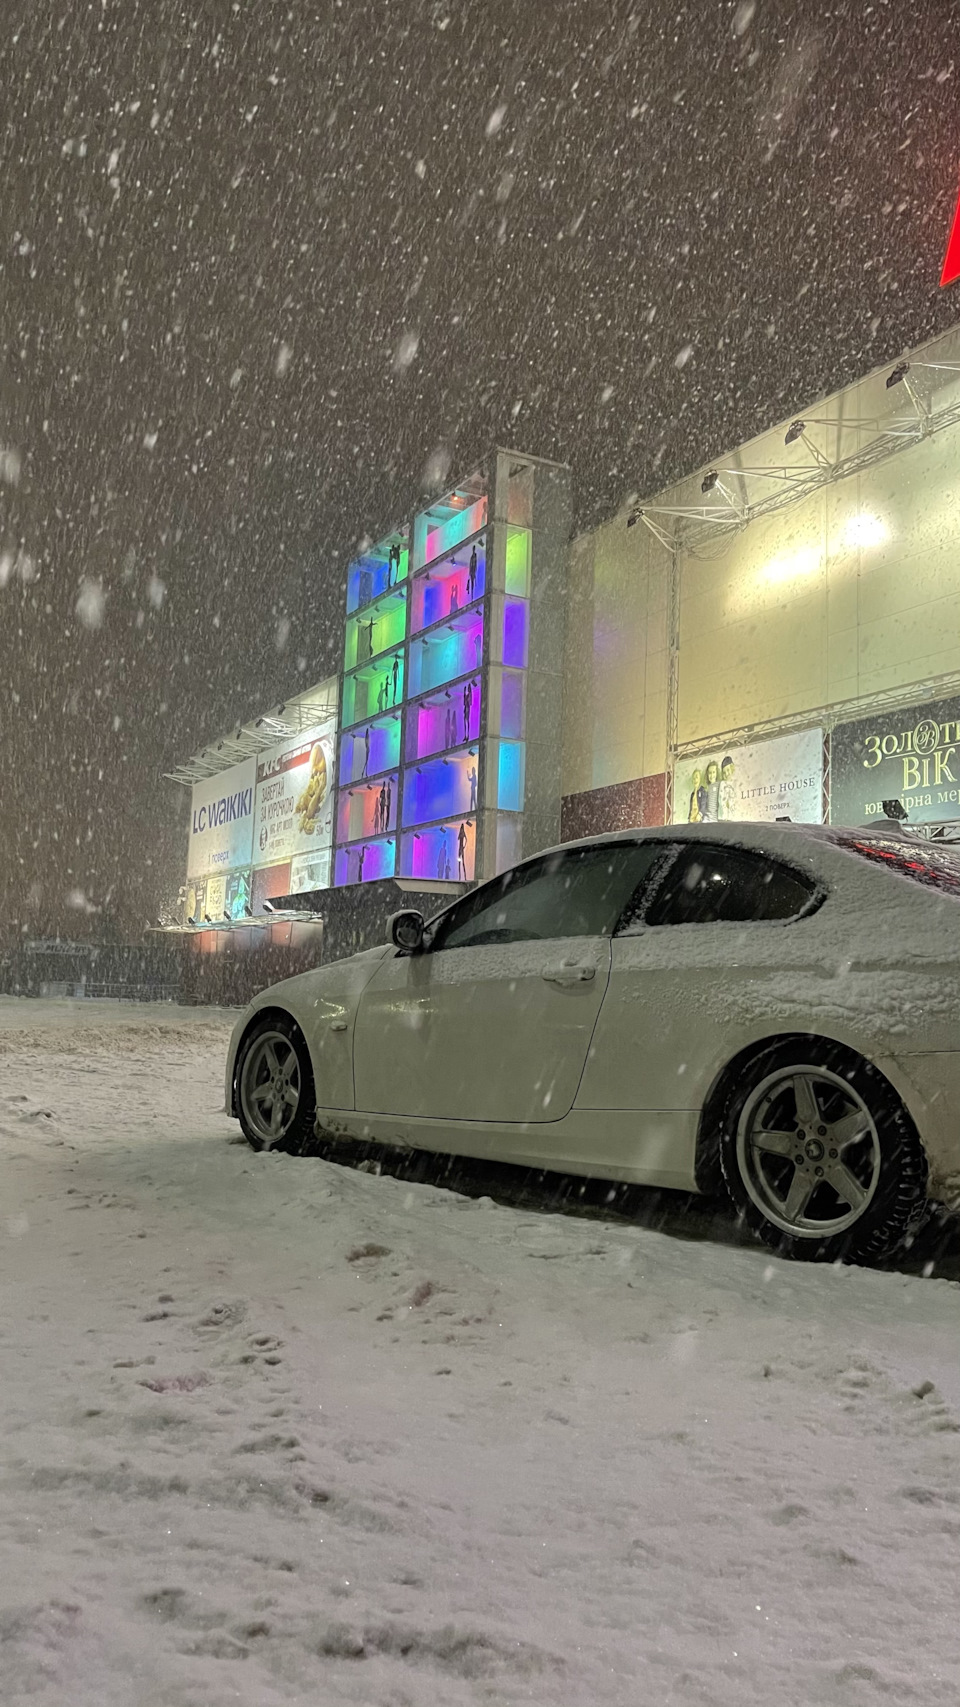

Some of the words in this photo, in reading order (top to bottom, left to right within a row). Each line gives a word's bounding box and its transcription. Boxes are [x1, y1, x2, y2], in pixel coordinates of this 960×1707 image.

[263, 756, 282, 777] KFC
[902, 747, 957, 790] ВІК
[740, 785, 776, 799] LITTLE
[779, 777, 815, 792] HOUSE
[193, 807, 206, 834] LC
